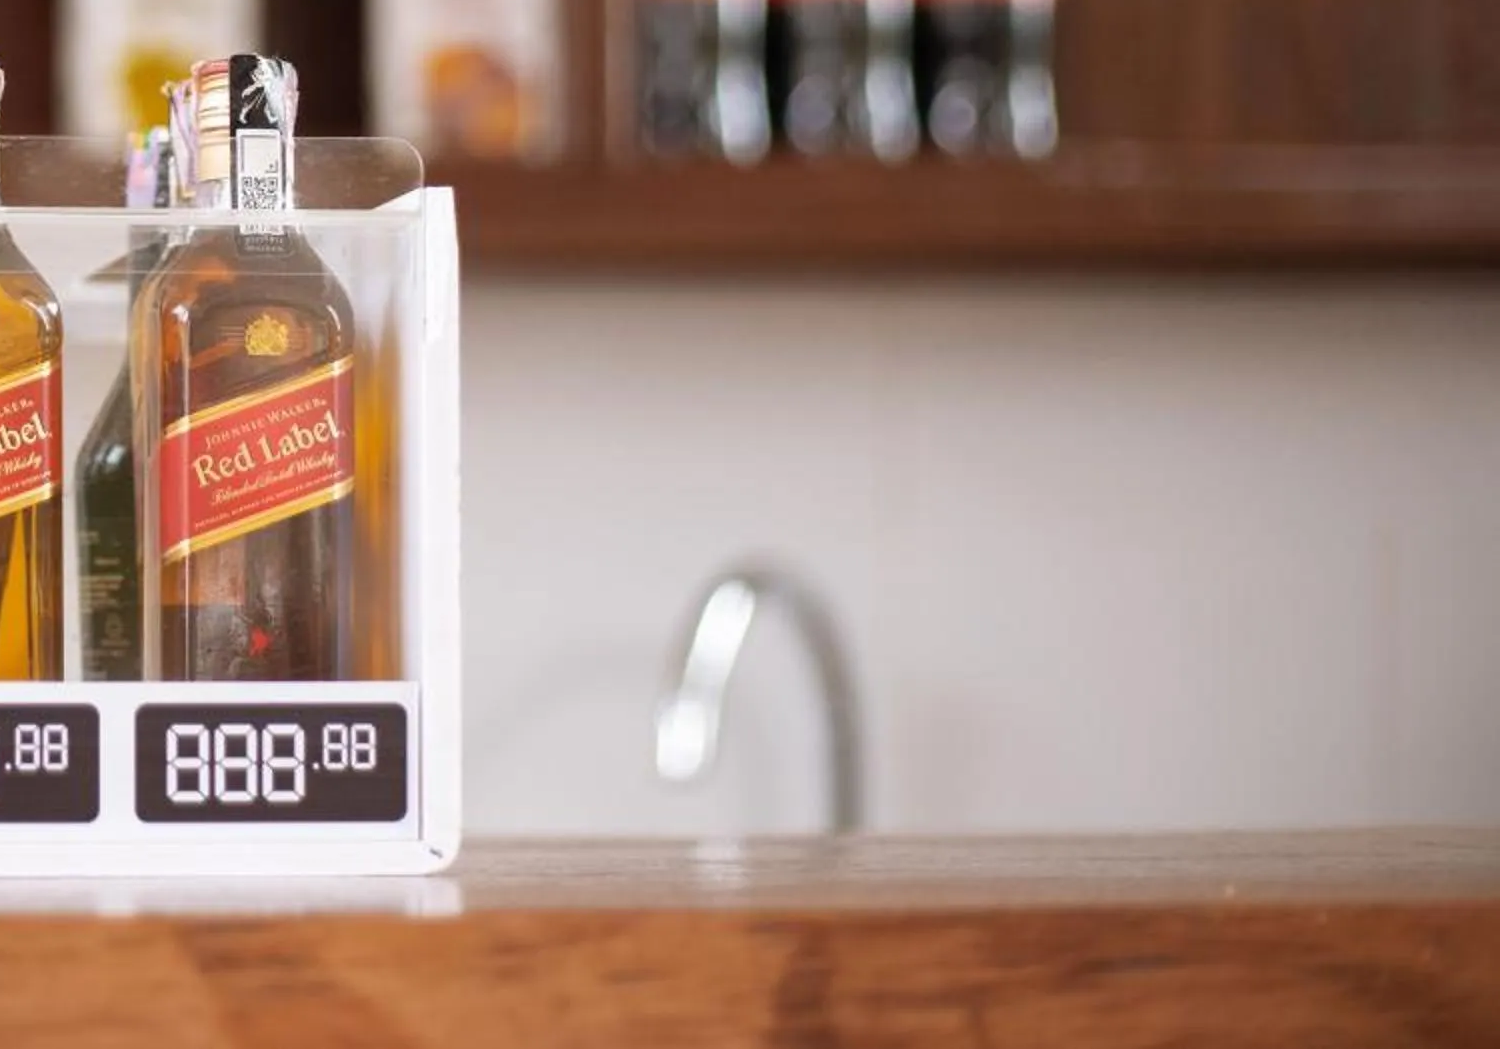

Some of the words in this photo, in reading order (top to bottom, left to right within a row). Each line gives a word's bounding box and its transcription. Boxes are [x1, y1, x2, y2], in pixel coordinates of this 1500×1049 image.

[191, 441, 256, 488] Red
[258, 409, 341, 465] Label
[204, 420, 265, 450] JOHNNIE
[1, 450, 43, 477] Whisky
[292, 450, 336, 477] Whisky
